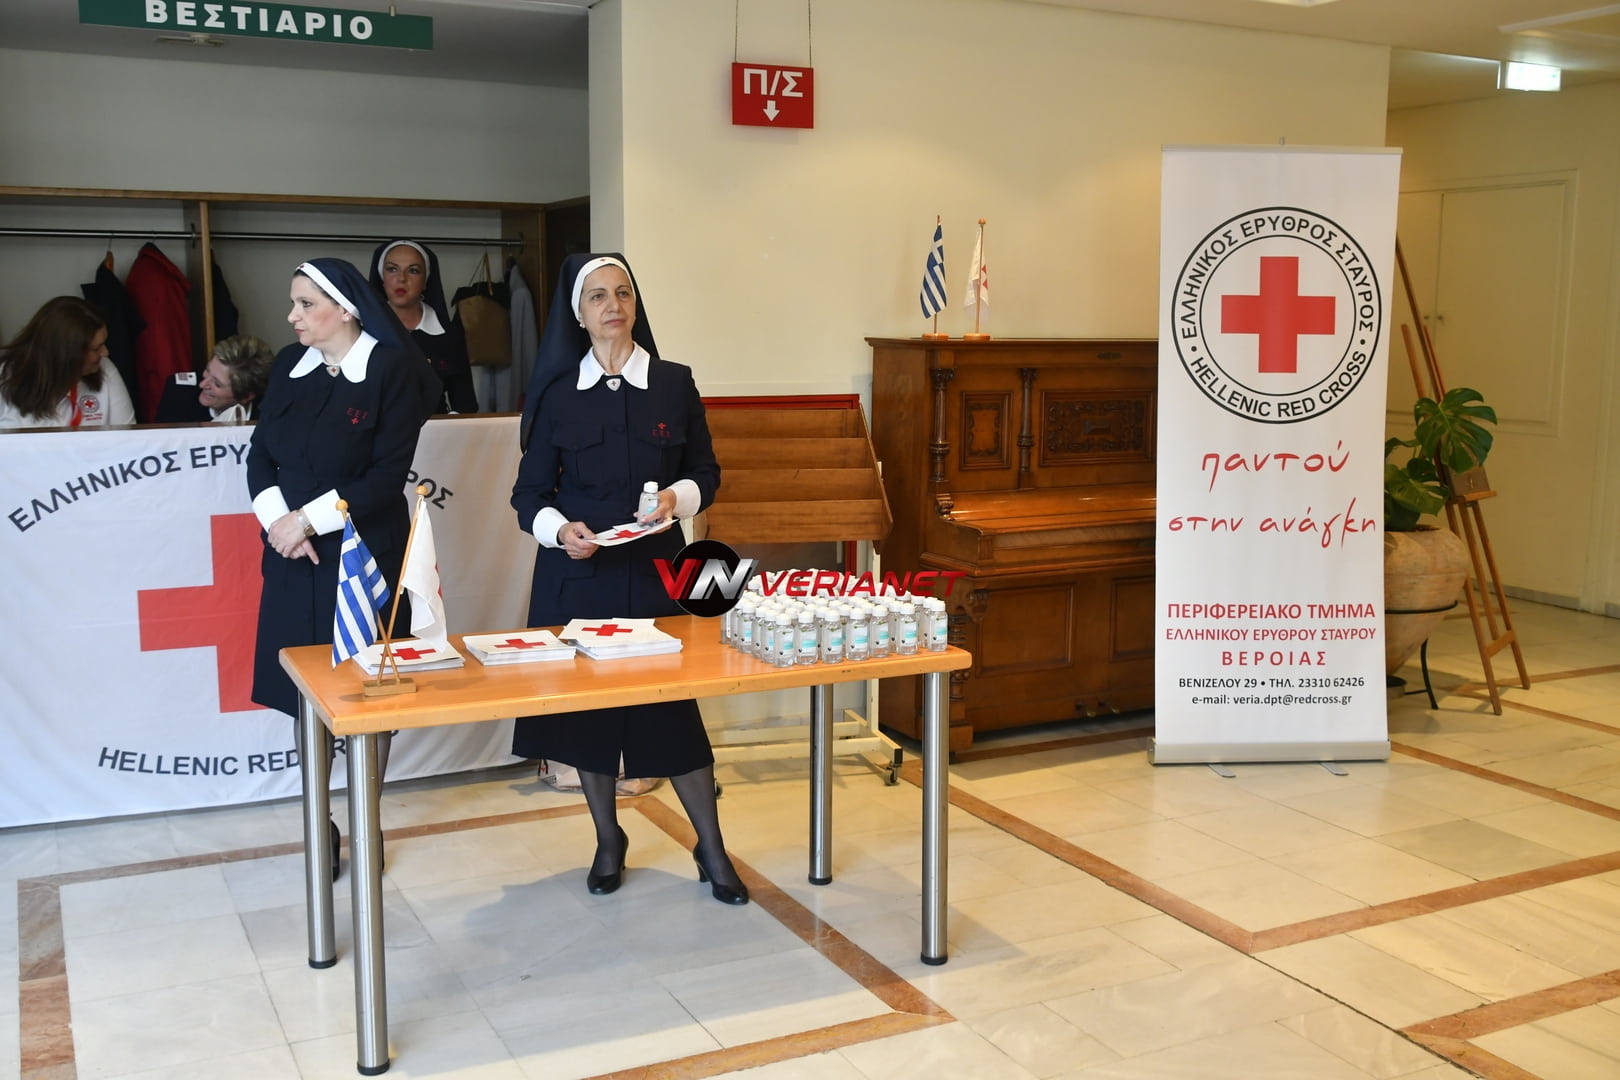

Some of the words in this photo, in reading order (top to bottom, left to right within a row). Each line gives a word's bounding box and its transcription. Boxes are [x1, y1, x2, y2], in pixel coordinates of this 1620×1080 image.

[145, 0, 373, 40] ΒΕΣΤΙΑΡΙΟ
[743, 67, 804, 98] Π/Σ
[1180, 229, 1239, 339] ΕΛΛΗΝΙΚΟΣ
[1239, 215, 1338, 248] ΕΡΥΘΡΟΣ
[1335, 243, 1375, 332] ΣΤΑΥΡΟΣ
[1189, 356, 1271, 416] HELLENIC
[1277, 396, 1317, 418] RED
[1318, 350, 1367, 404] CROSS
[1201, 439, 1350, 493] παντού
[8, 450, 181, 533] ΕΛΛΗΝΙΚΟΣ
[1168, 515, 1244, 532] στην
[1259, 497, 1376, 549] ανάγκη
[1167, 603, 1301, 620] ΠΕΡΙΦΕΡΕΙΑΚΟ
[1307, 603, 1376, 619] ΤΜΗΜΑ
[1166, 628, 1249, 641] ΕΛΛΗΝΙΚΟΥ
[1253, 628, 1317, 641] ΕΡΥΘΡΟΥ
[1321, 627, 1376, 641] ΣΤΑΥΡΟΥ
[1221, 651, 1327, 666] ΒΕΡΟΙΑΣ
[1178, 678, 1241, 688] ΒΕΝΙΖΕΛΟΥ
[1244, 678, 1258, 688] 29
[1269, 678, 1295, 688] ΤΗΛ.
[1298, 678, 1331, 688] 23310
[1333, 677, 1365, 687] 62426
[1191, 694, 1230, 704] e-mail:
[1233, 694, 1352, 706] veria.dpt@redcross.gr
[98, 747, 238, 776] HELLENIC
[247, 750, 300, 774] RED
